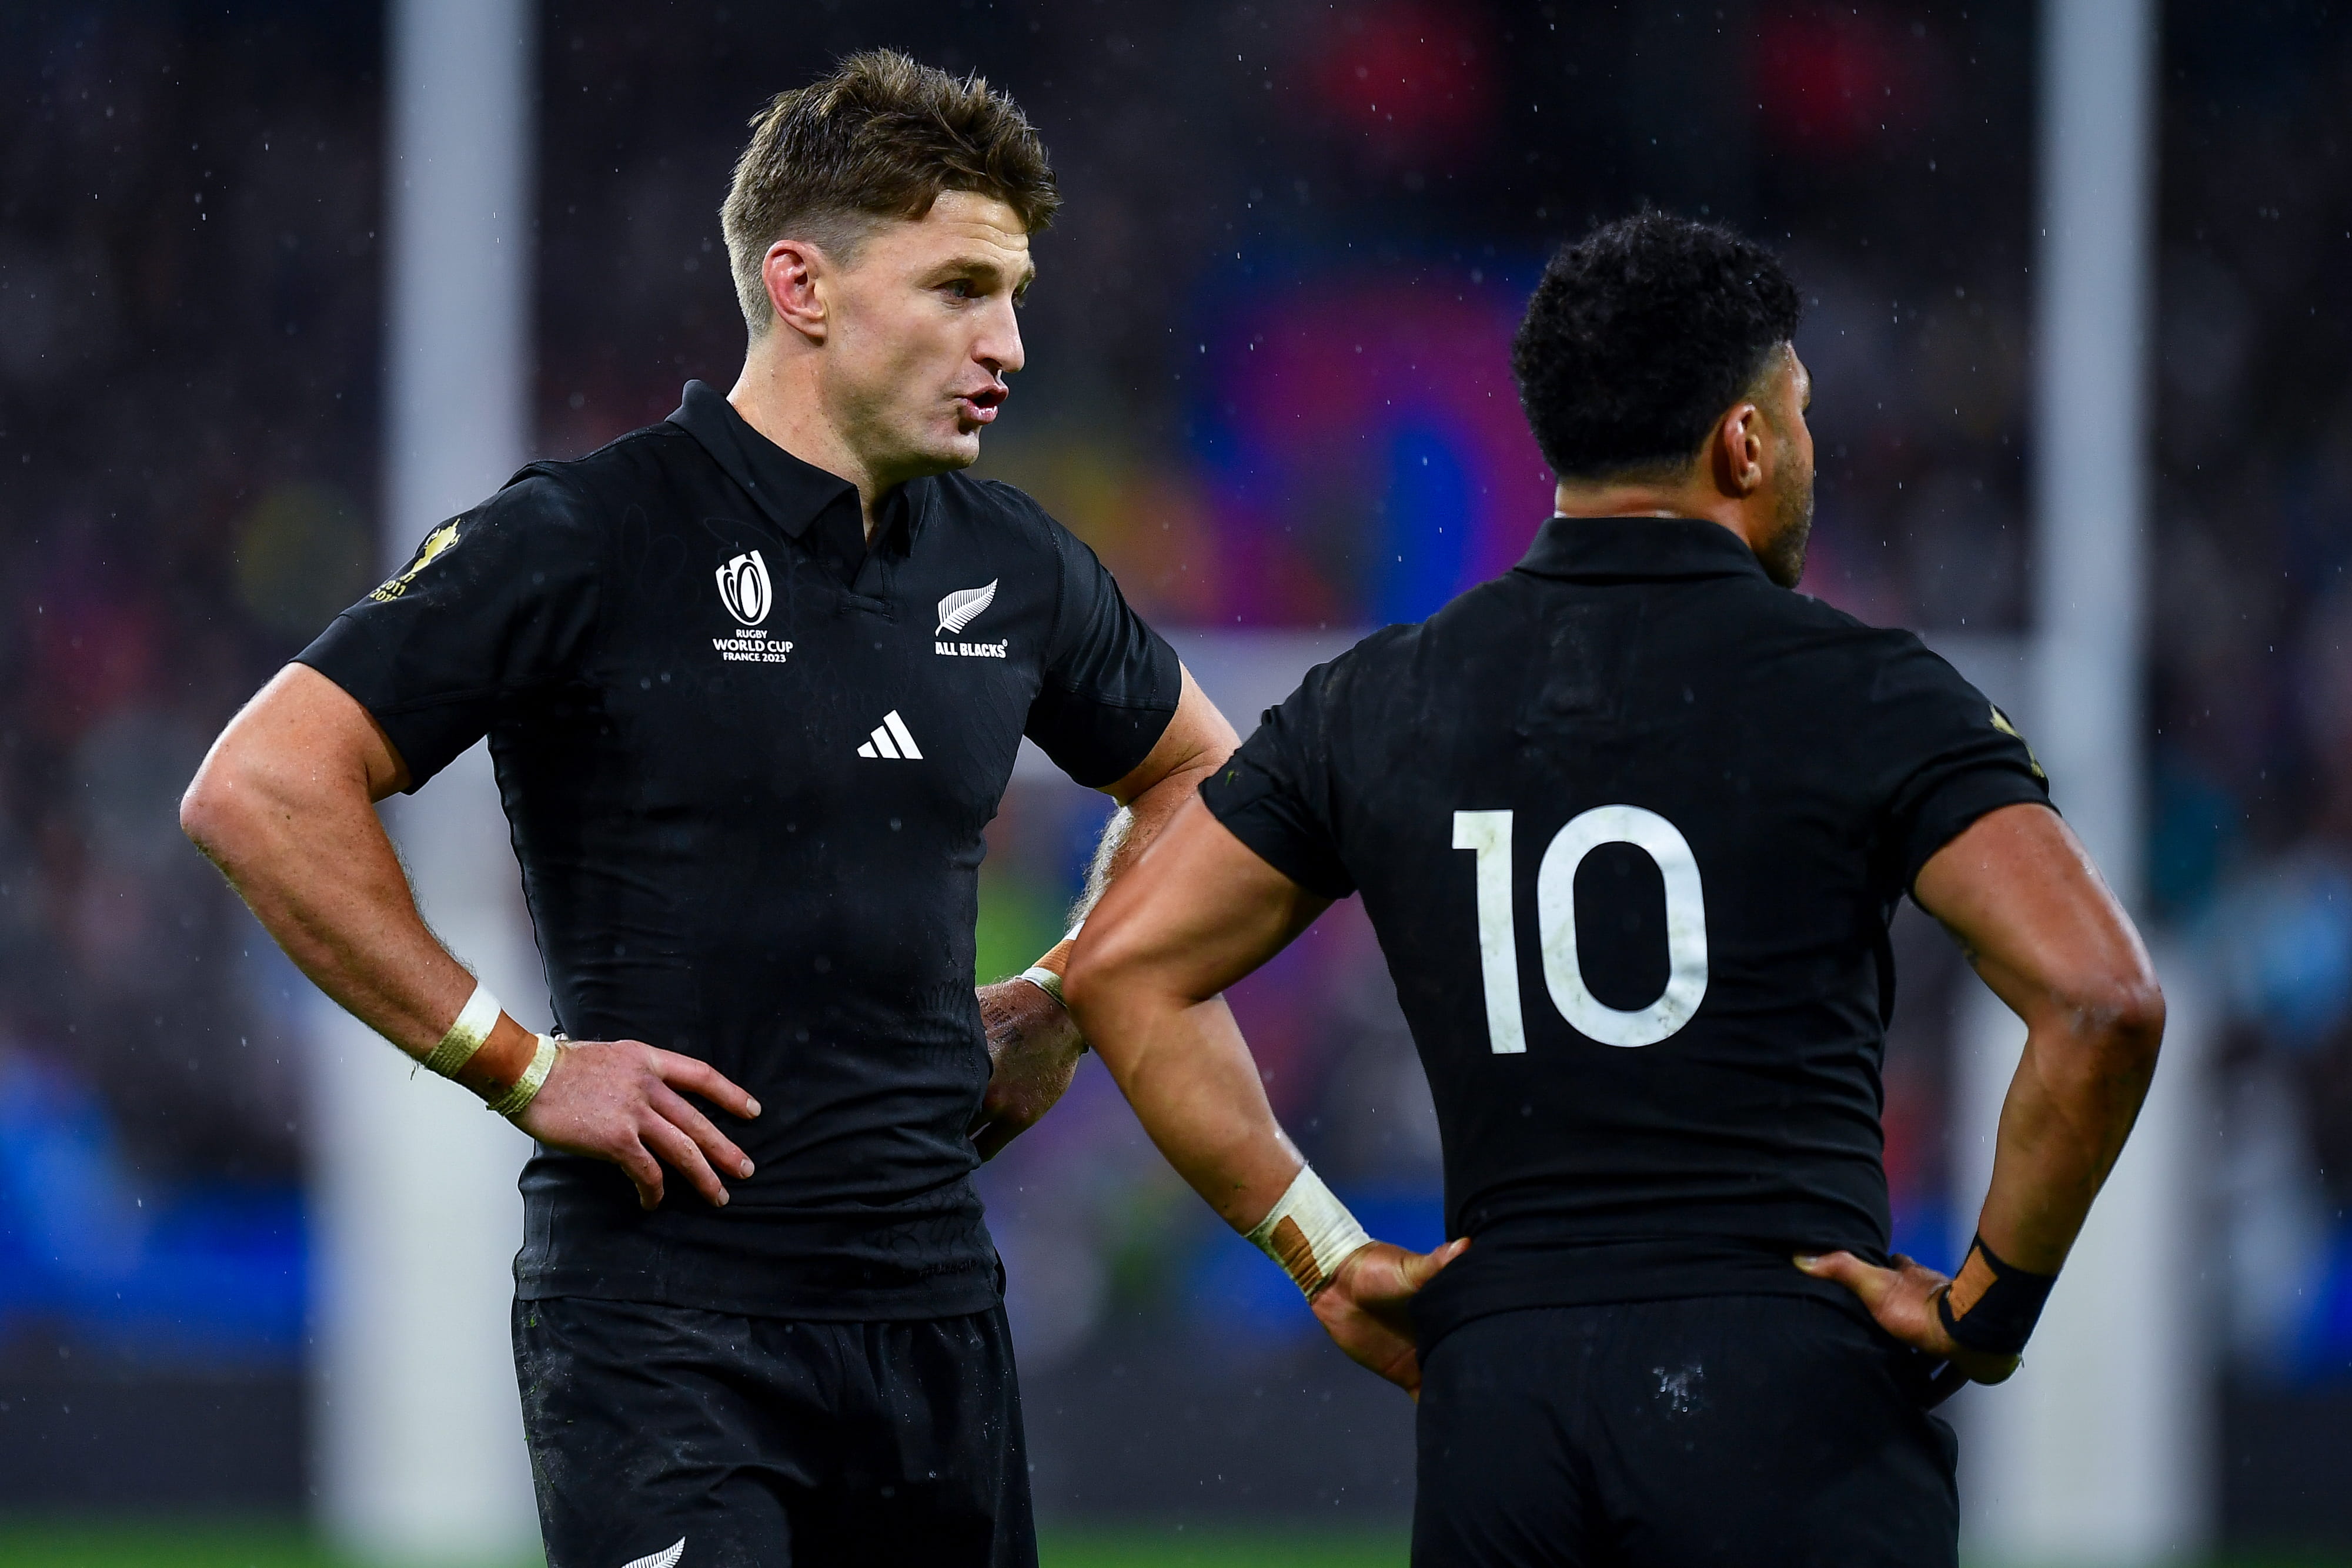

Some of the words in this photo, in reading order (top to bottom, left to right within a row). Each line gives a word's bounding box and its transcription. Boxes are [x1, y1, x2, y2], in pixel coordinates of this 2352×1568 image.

[736, 629, 768, 638] RUGBY
[712, 638, 764, 652] WORLD
[767, 640, 794, 653] CUP
[935, 641, 958, 656] ALL
[959, 643, 1007, 658] BLACKS
[723, 651, 761, 661] FRANCE
[762, 653, 787, 663] 2023
[1452, 803, 1709, 1055] 10
